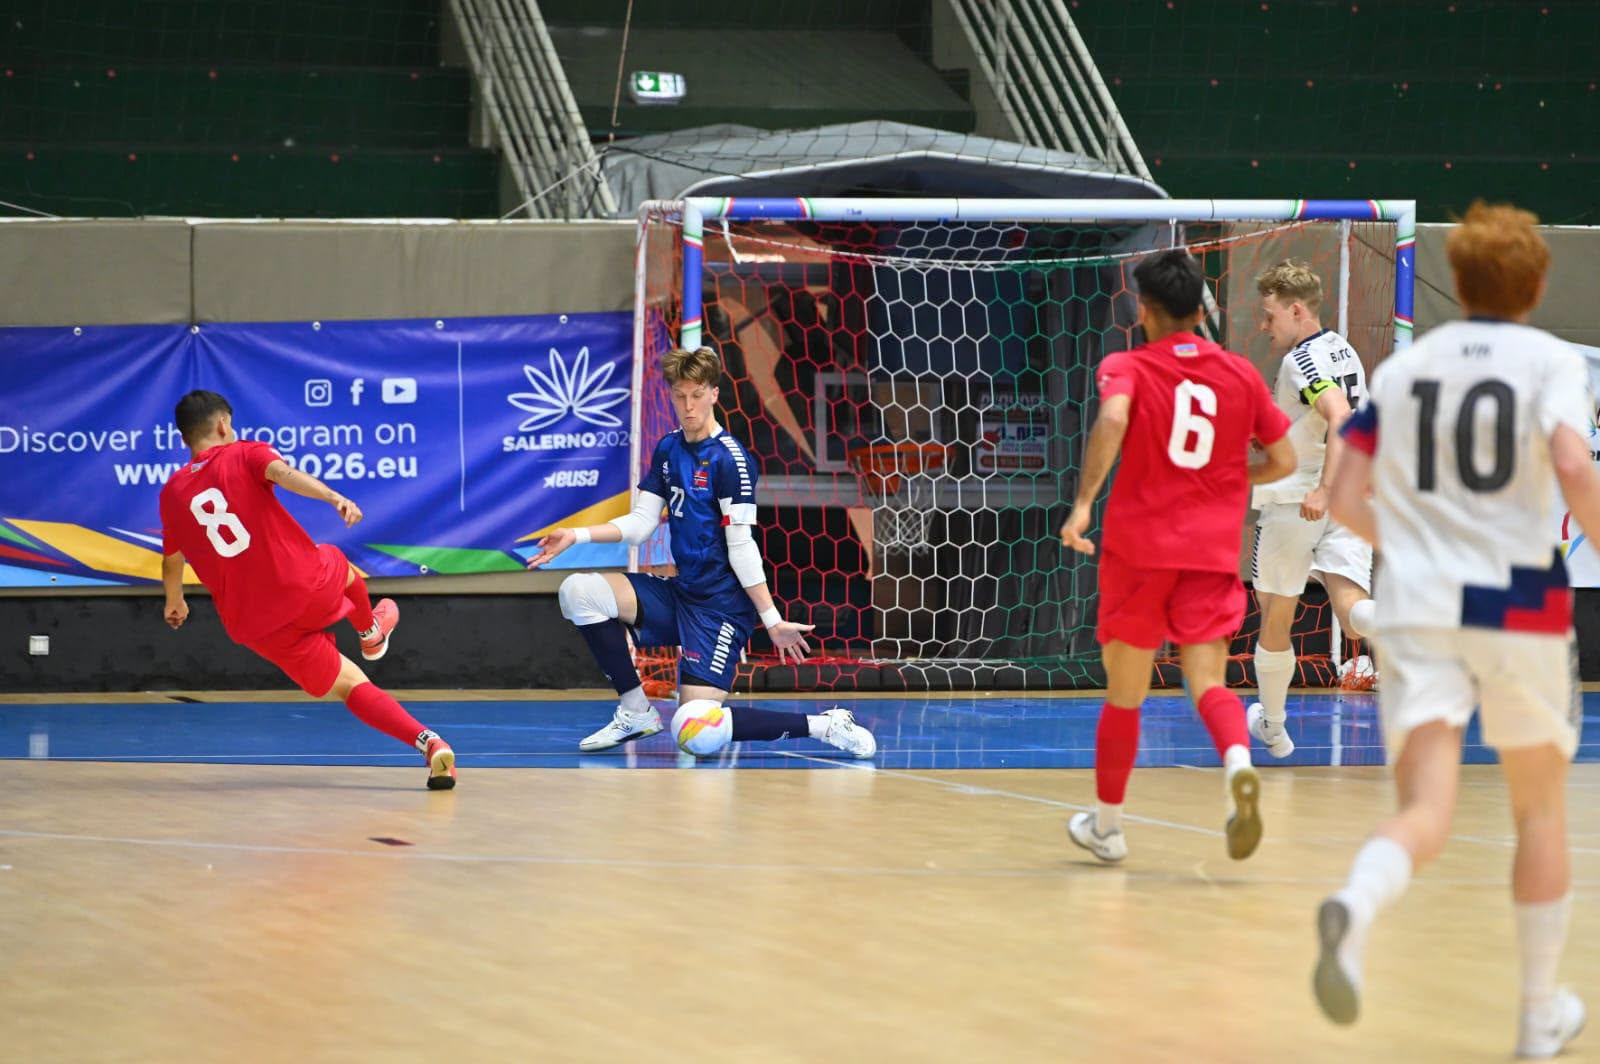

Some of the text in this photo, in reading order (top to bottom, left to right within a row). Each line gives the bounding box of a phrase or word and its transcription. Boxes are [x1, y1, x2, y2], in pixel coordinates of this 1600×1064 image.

[0, 422, 417, 453] Discover th rogram on
[502, 431, 633, 453] SALERNO202
[1168, 379, 1217, 469] 6
[1411, 379, 1517, 492] 10
[189, 487, 251, 558] 8
